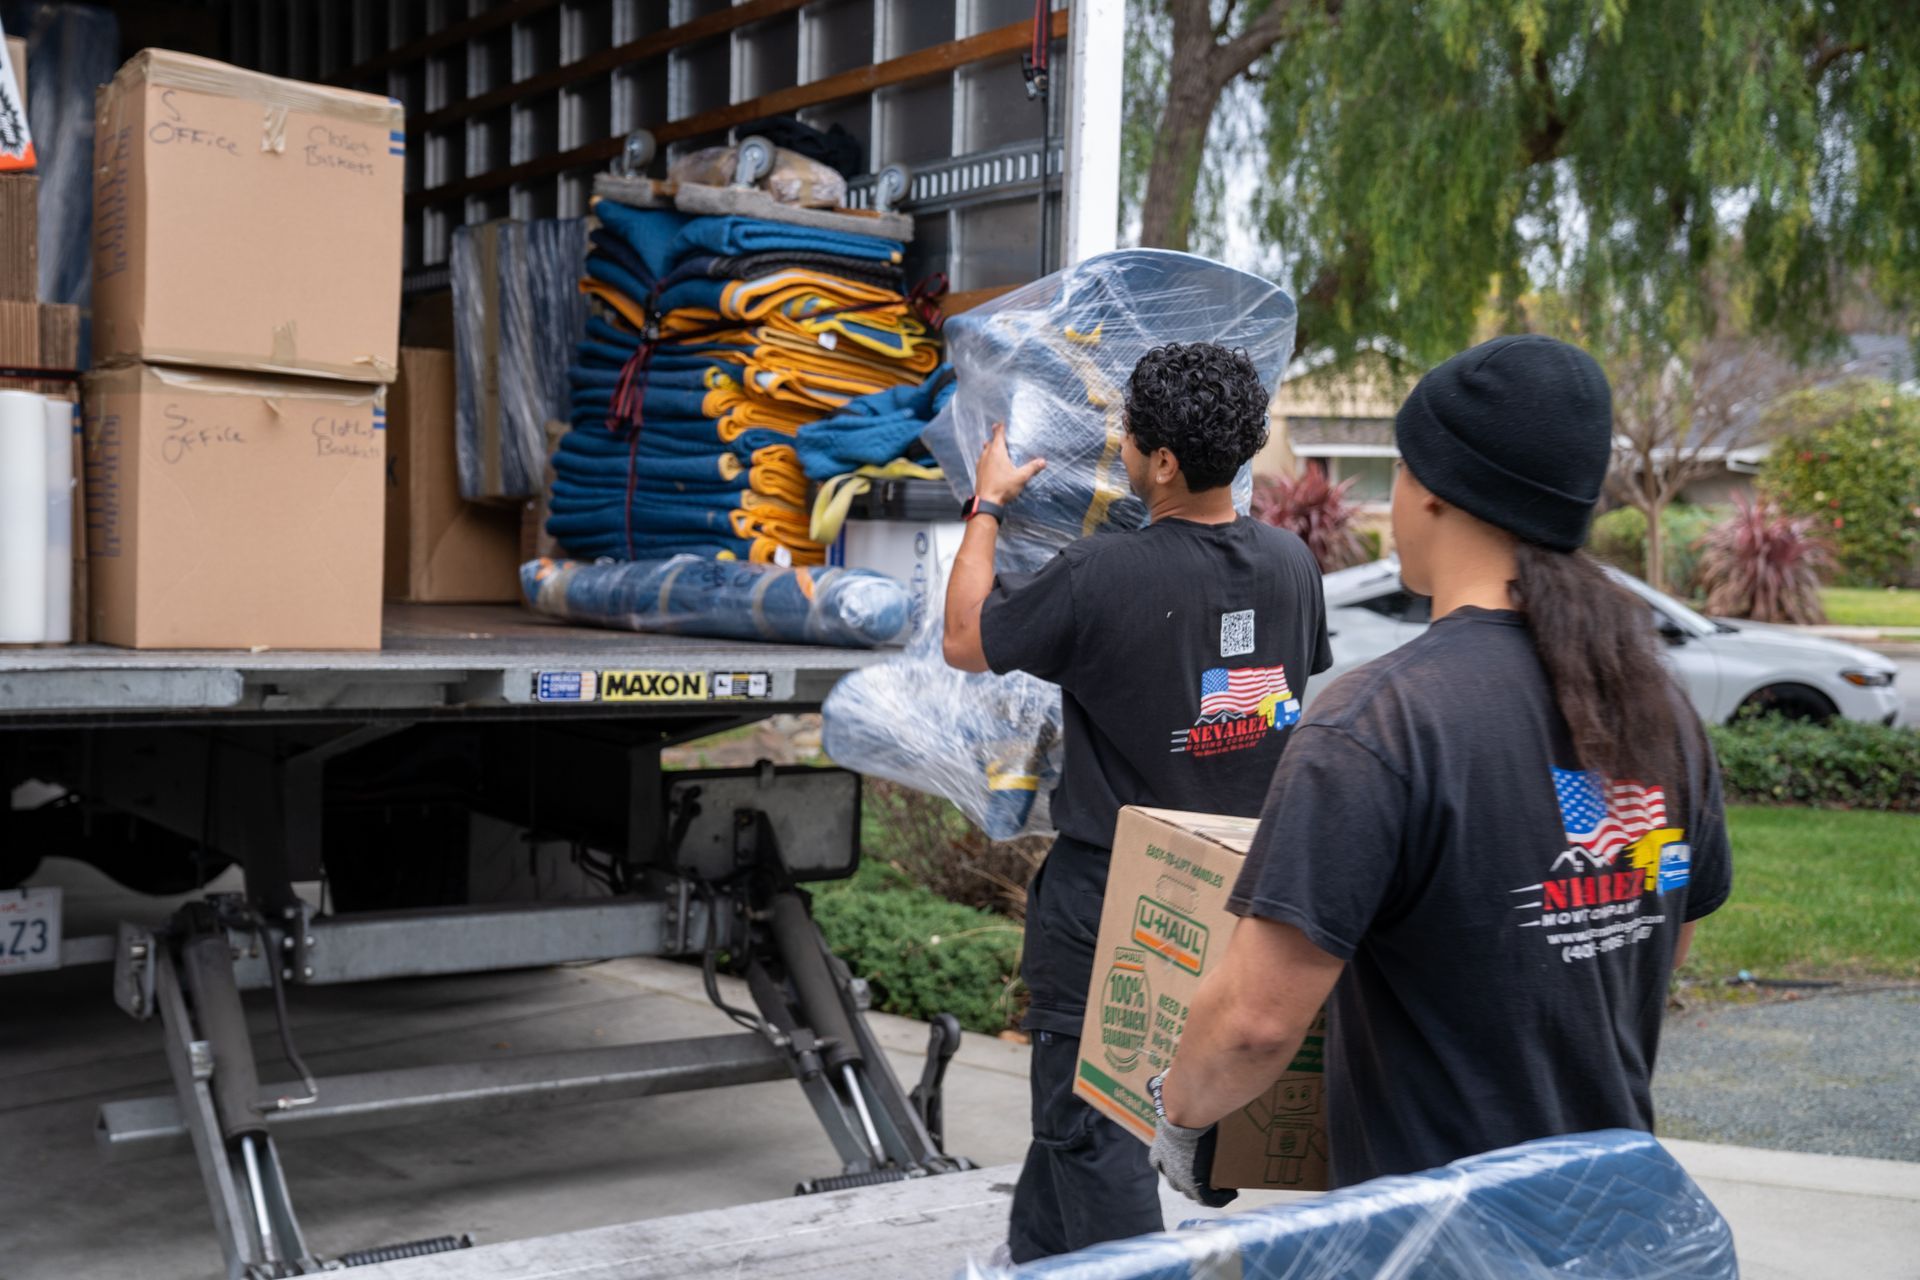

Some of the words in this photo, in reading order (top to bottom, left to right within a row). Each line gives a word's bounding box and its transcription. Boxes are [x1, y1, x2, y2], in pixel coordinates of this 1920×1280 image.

[605, 674, 701, 697] MAXON
[1186, 740, 1223, 751] MOVING
[1226, 732, 1266, 745] COMPANY
[1187, 715, 1268, 743] NEVAREZ
[1139, 904, 1201, 955] U-HAUL
[1111, 973, 1145, 1008] 100%
